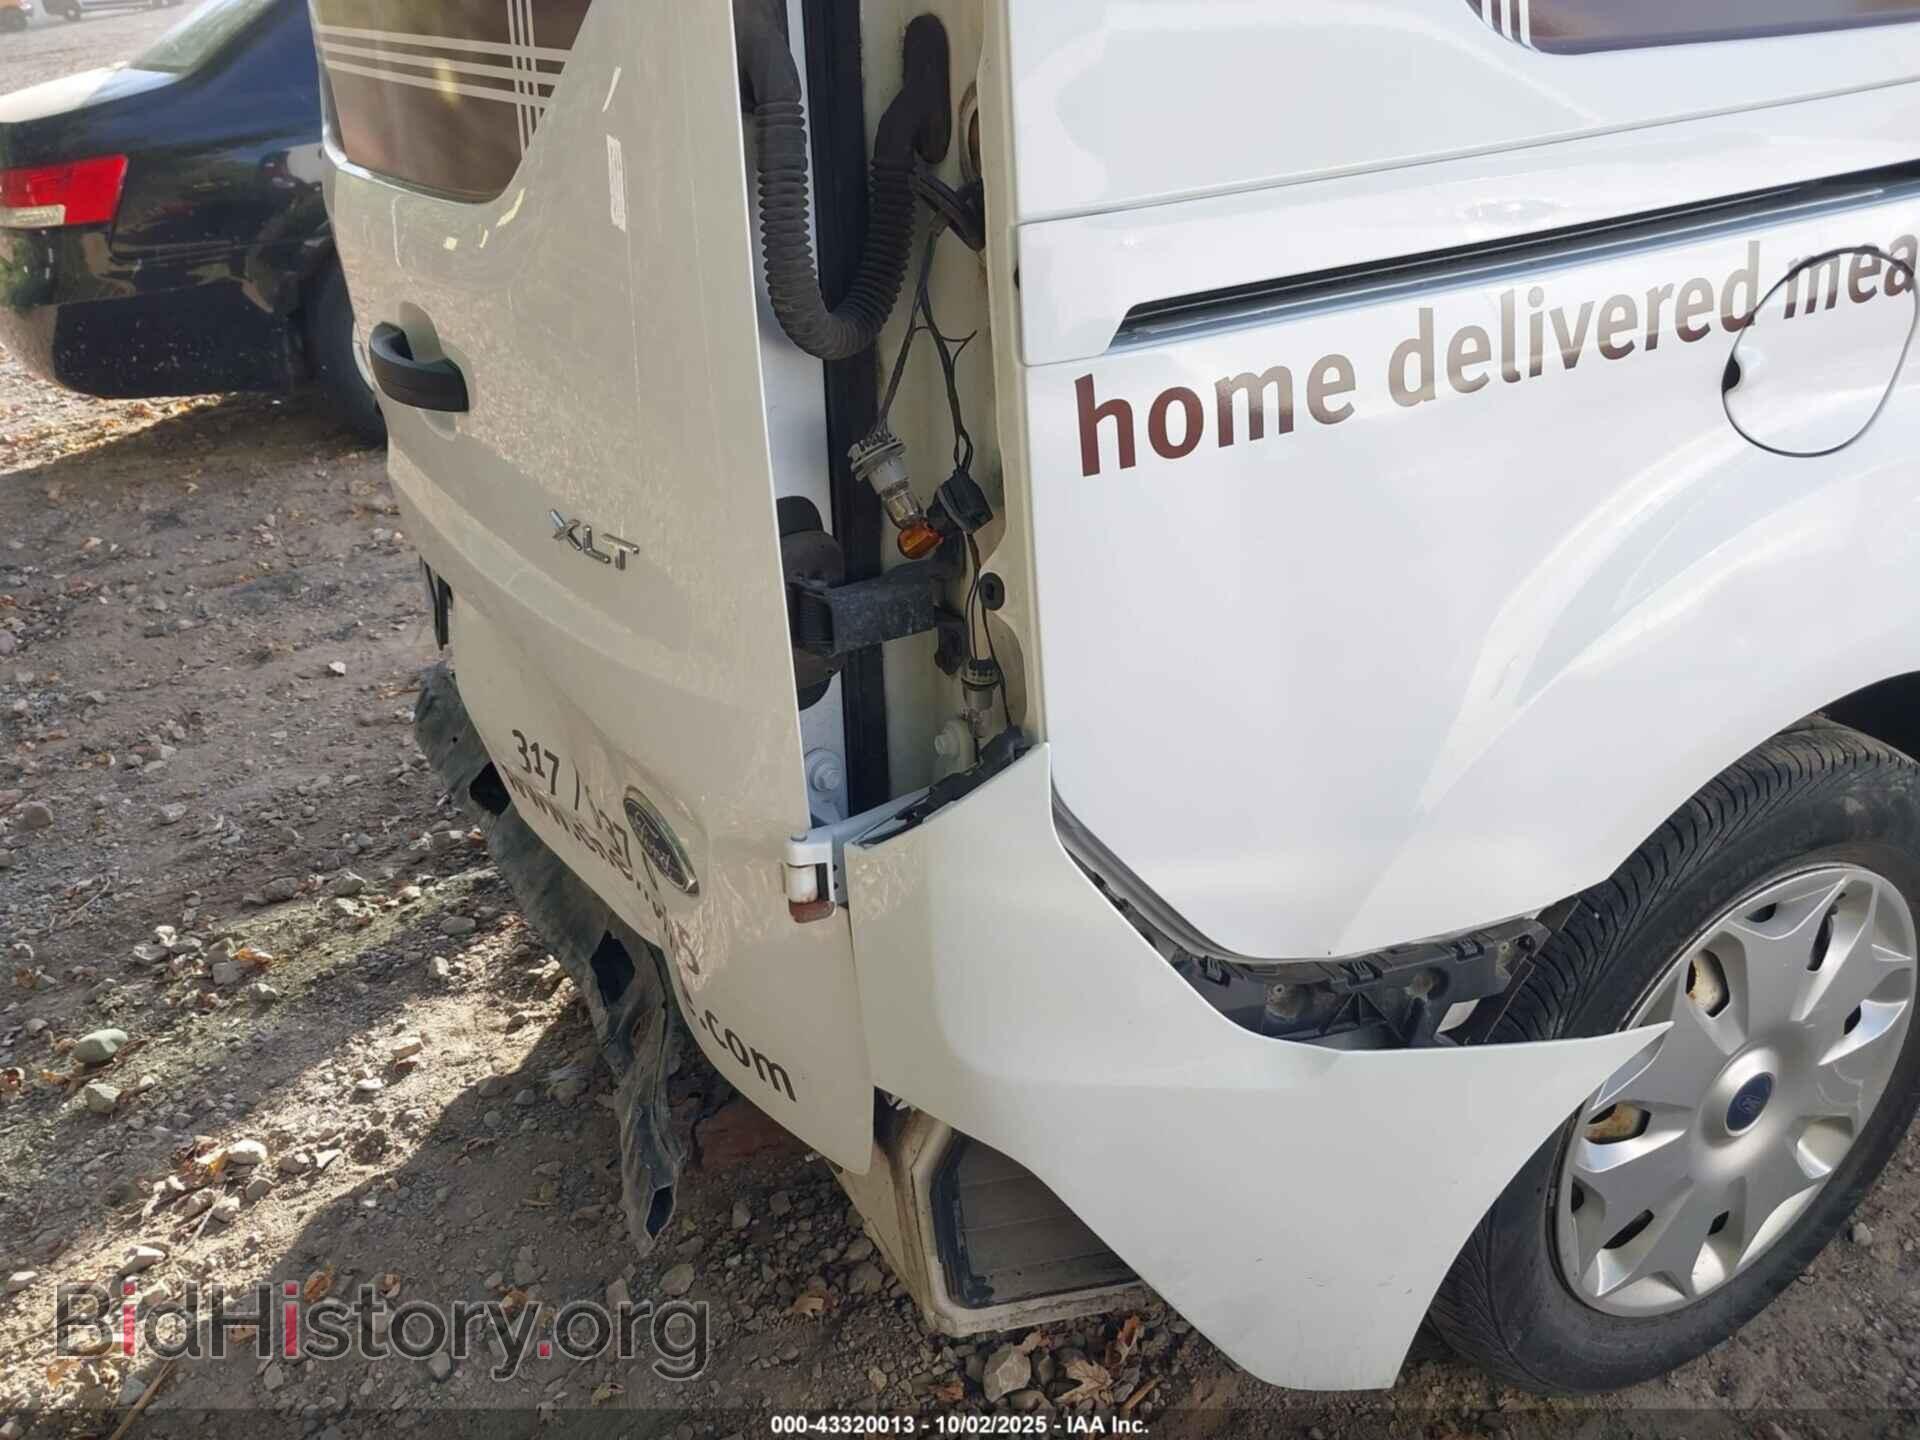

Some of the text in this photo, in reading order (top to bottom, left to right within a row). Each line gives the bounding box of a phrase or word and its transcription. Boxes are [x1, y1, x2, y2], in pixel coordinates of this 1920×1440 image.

[1074, 234, 1919, 477] home delivered mea
[550, 508, 640, 572] XLT
[511, 729, 560, 796] 317
